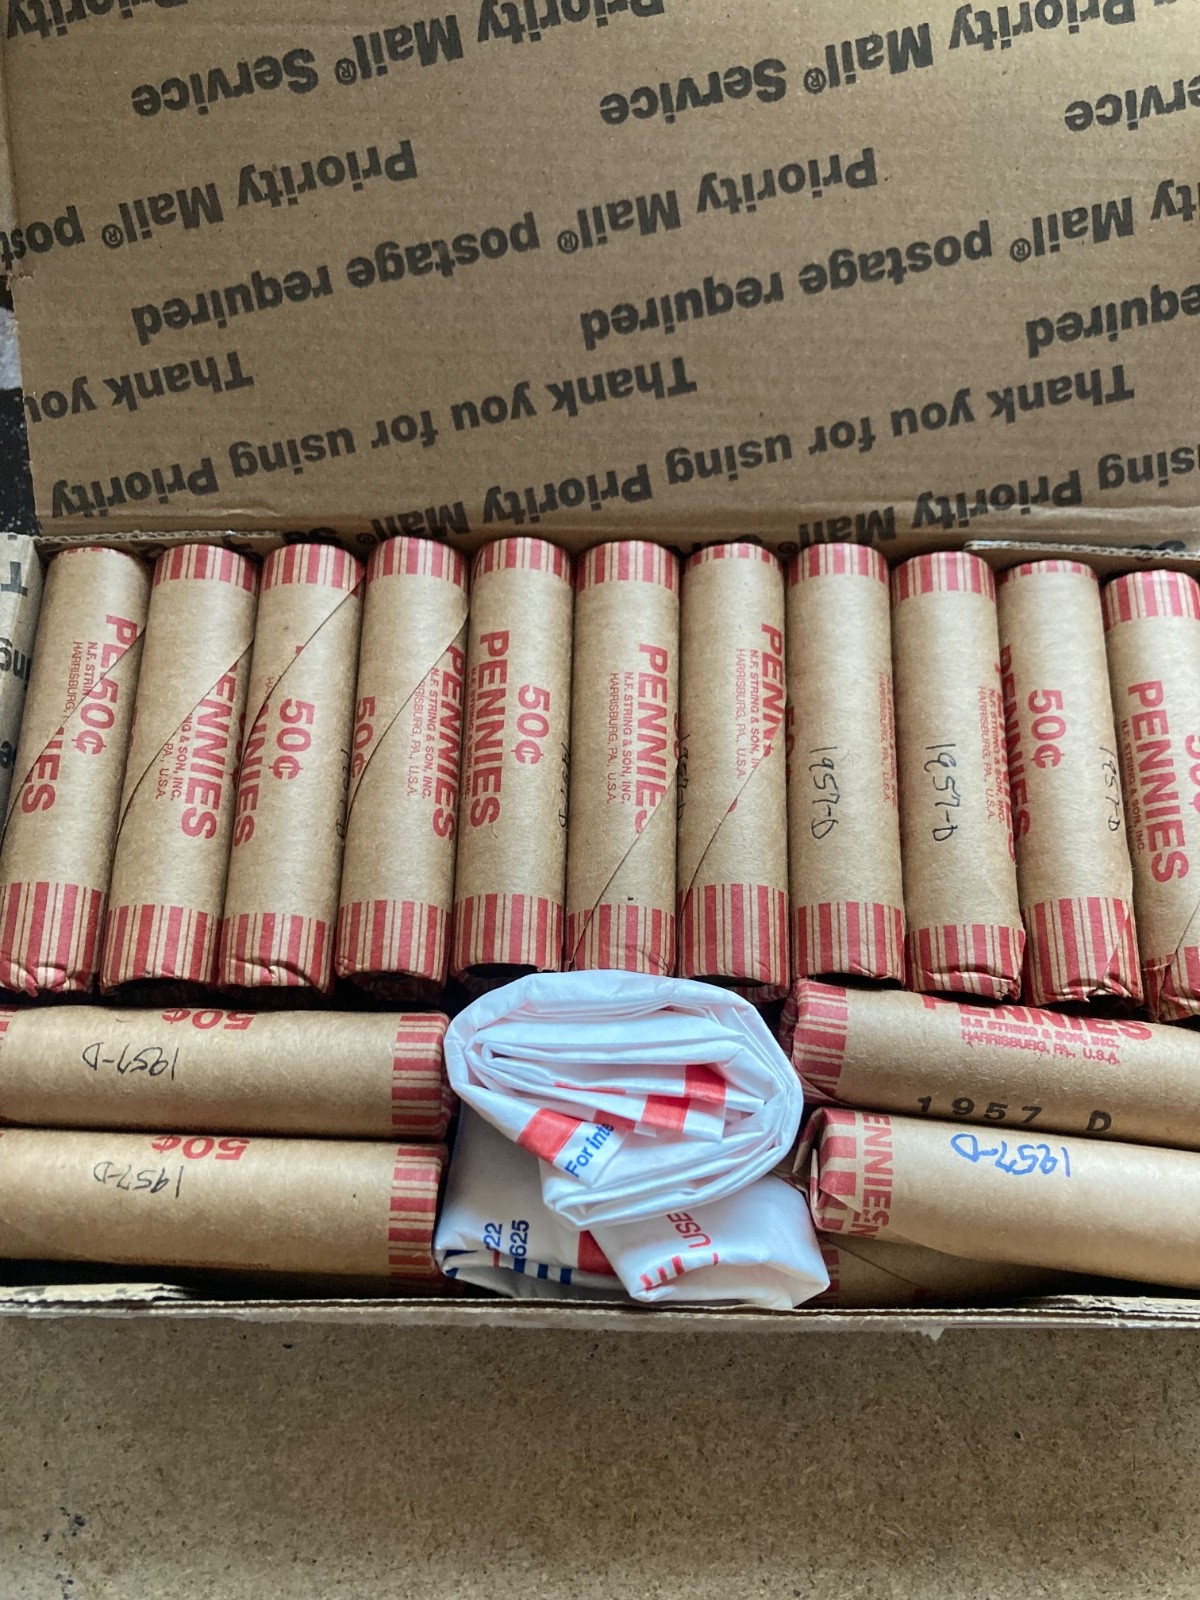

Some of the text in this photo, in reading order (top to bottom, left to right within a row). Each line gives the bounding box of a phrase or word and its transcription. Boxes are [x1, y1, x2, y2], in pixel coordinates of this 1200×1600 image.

[131, 47, 320, 117] Service
[601, 58, 788, 126] Service
[237, 139, 418, 207] Priority
[697, 147, 878, 214] Priority
[346, 211, 541, 289] postage
[798, 220, 993, 300] postage
[132, 264, 334, 346] required
[579, 272, 784, 353] required
[105, 351, 255, 412] Thank
[987, 364, 1135, 424] Thank
[51, 356, 698, 519] Thank you for using Priority
[807, 416, 877, 456] for
[891, 388, 976, 439] you
[666, 434, 794, 485] using
[1098, 442, 1200, 492] sing
[481, 464, 652, 528] Priority
[911, 469, 1083, 530] Priority
[71, 677, 120, 755] 50¢
[425, 690, 438, 731] STRING
[607, 672, 620, 745] HARRISBURG,
[623, 692, 633, 736] STRING
[749, 673, 760, 713] STRING
[749, 716, 760, 724] &
[268, 698, 316, 781] 50¢
[469, 630, 510, 828] PENNIES
[510, 684, 552, 765] 50¢
[622, 739, 632, 748] &
[749, 727, 760, 754] SON,
[1027, 689, 1067, 769] 50¢
[605, 772, 618, 805] U.S.A.
[620, 779, 631, 805] INC.
[621, 749, 632, 778] SON,
[735, 748, 747, 780] U.S.A.
[808, 746, 841, 840] 1957-D
[923, 743, 961, 842] 1957-D
[1099, 746, 1122, 832] 1957-D
[1121, 742, 1136, 785] STRING
[1128, 680, 1190, 883] PENNIES
[986, 1018, 1039, 1038] STRING
[82, 1042, 180, 1081] 1957-D
[1085, 1109, 1113, 1134] D
[93, 1161, 184, 1199] 1957-D
[564, 1146, 594, 1178] For
[950, 1133, 1071, 1178] 1957-D
